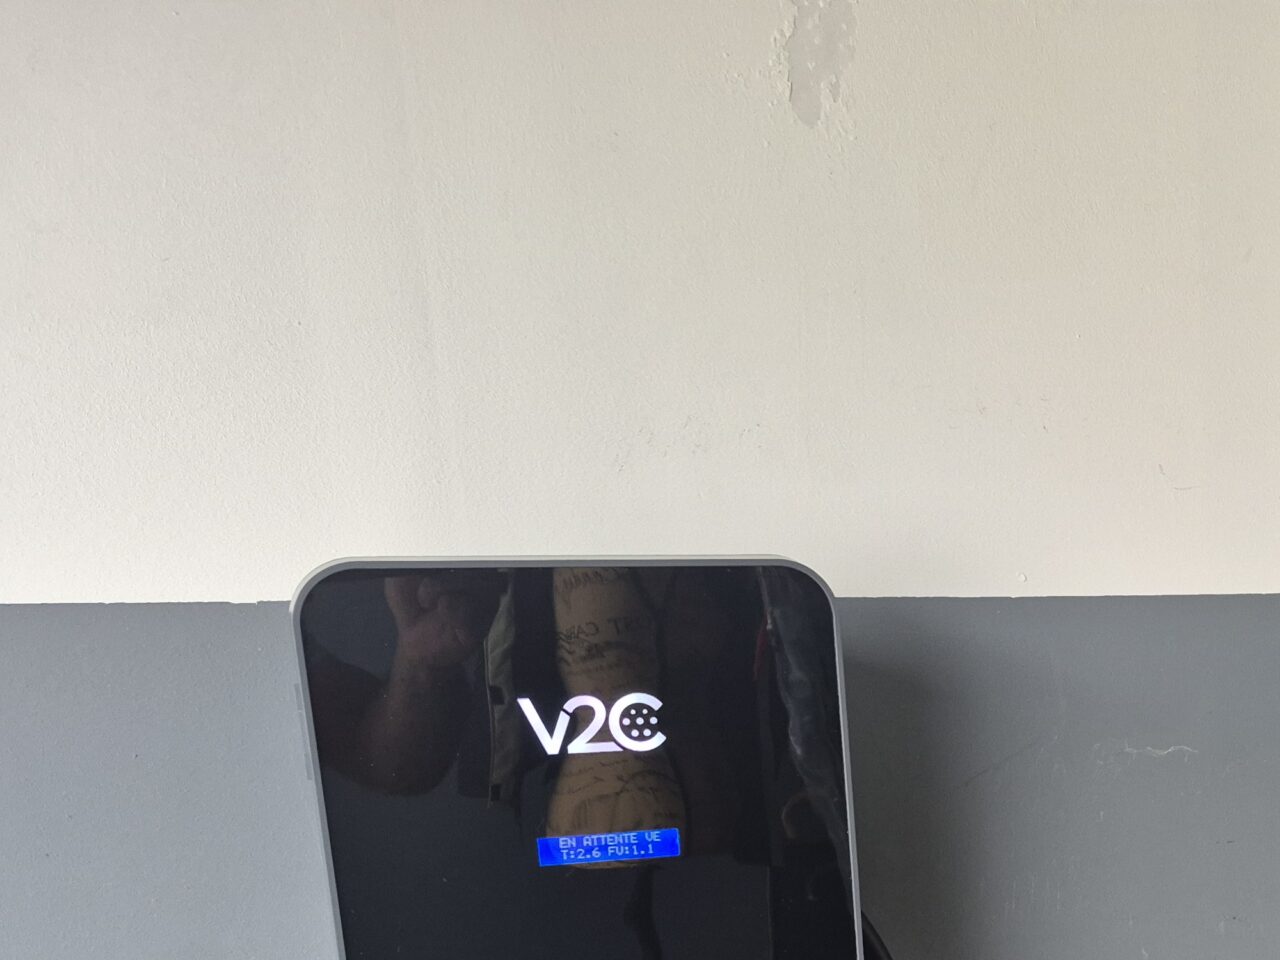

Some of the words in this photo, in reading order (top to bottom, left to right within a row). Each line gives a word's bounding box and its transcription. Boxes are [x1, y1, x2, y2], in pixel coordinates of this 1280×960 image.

[516, 692, 667, 756] V2C
[559, 836, 577, 849] EN
[582, 831, 639, 848] ATTENTE
[644, 830, 662, 843] VE
[560, 848, 602, 861] T:2.6
